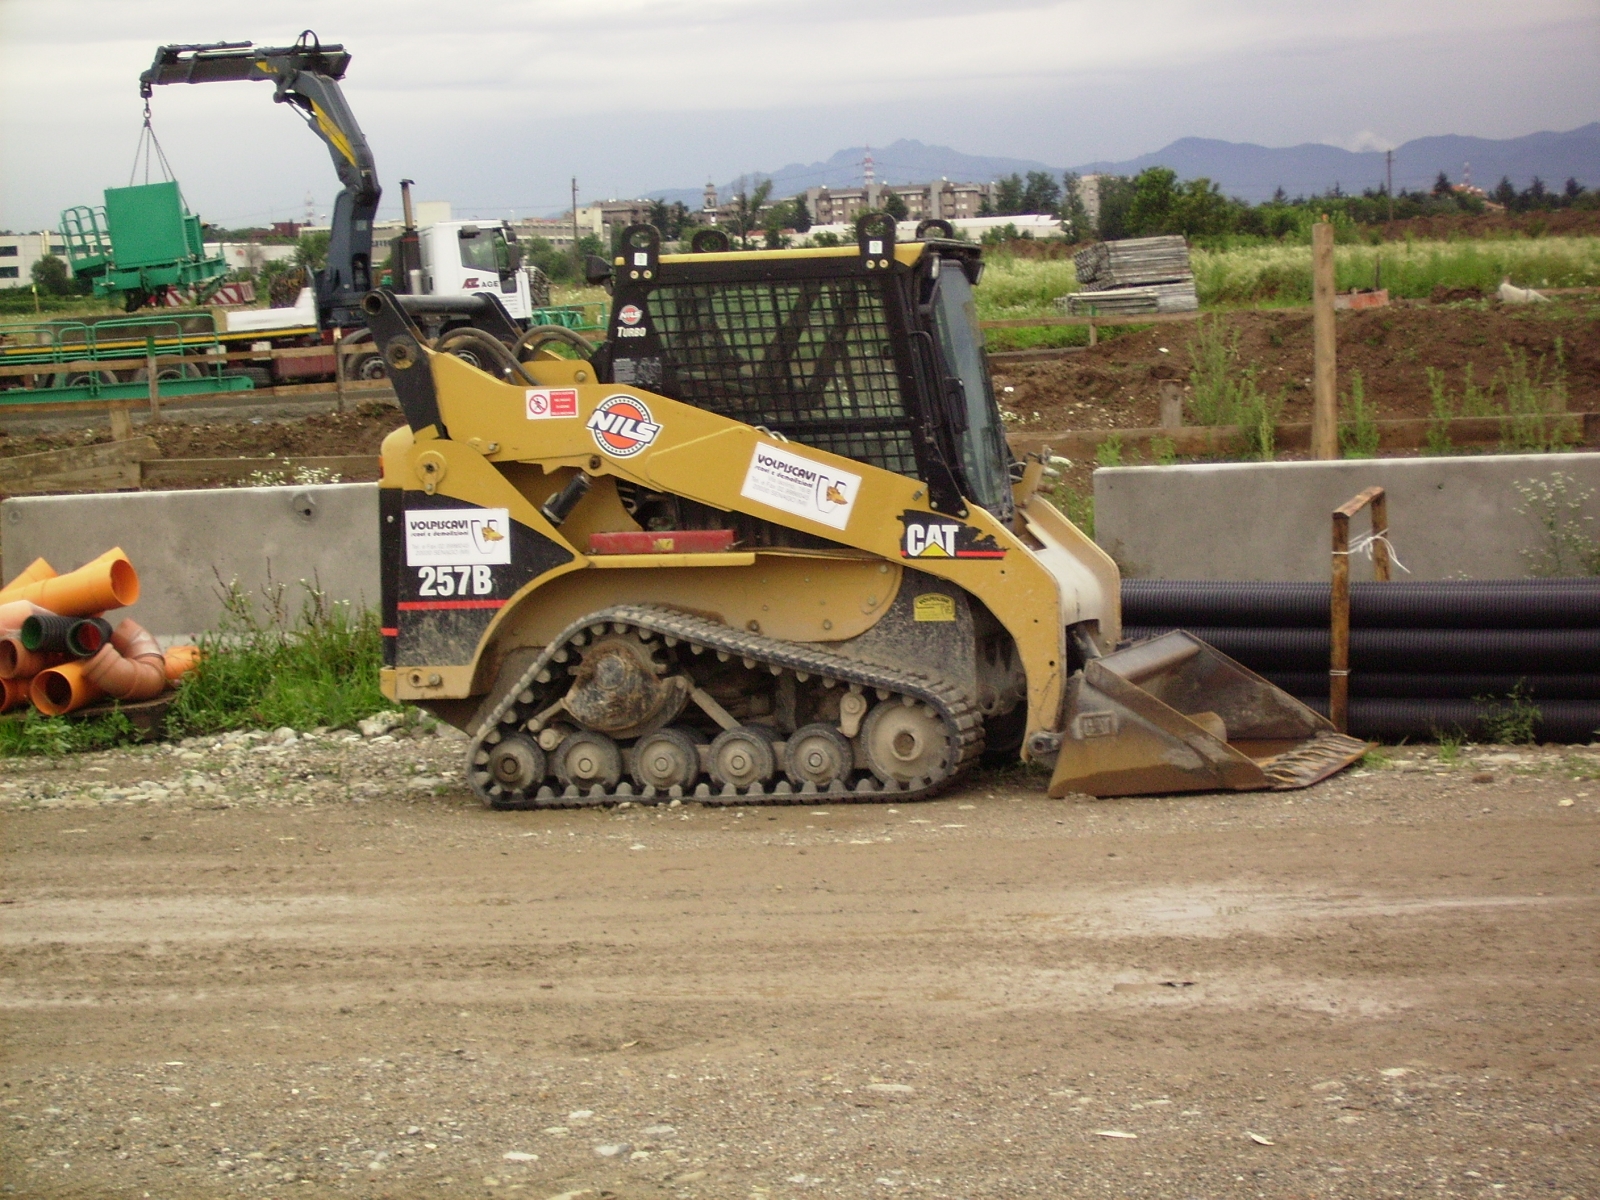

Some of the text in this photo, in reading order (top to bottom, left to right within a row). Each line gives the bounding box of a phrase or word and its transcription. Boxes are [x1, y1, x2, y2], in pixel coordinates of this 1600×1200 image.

[586, 408, 662, 445] NILS
[757, 453, 817, 482] VOLPISCAVI
[410, 519, 469, 531] VOLPISCAVI
[907, 523, 959, 557] CAT
[418, 565, 493, 597] 257B
